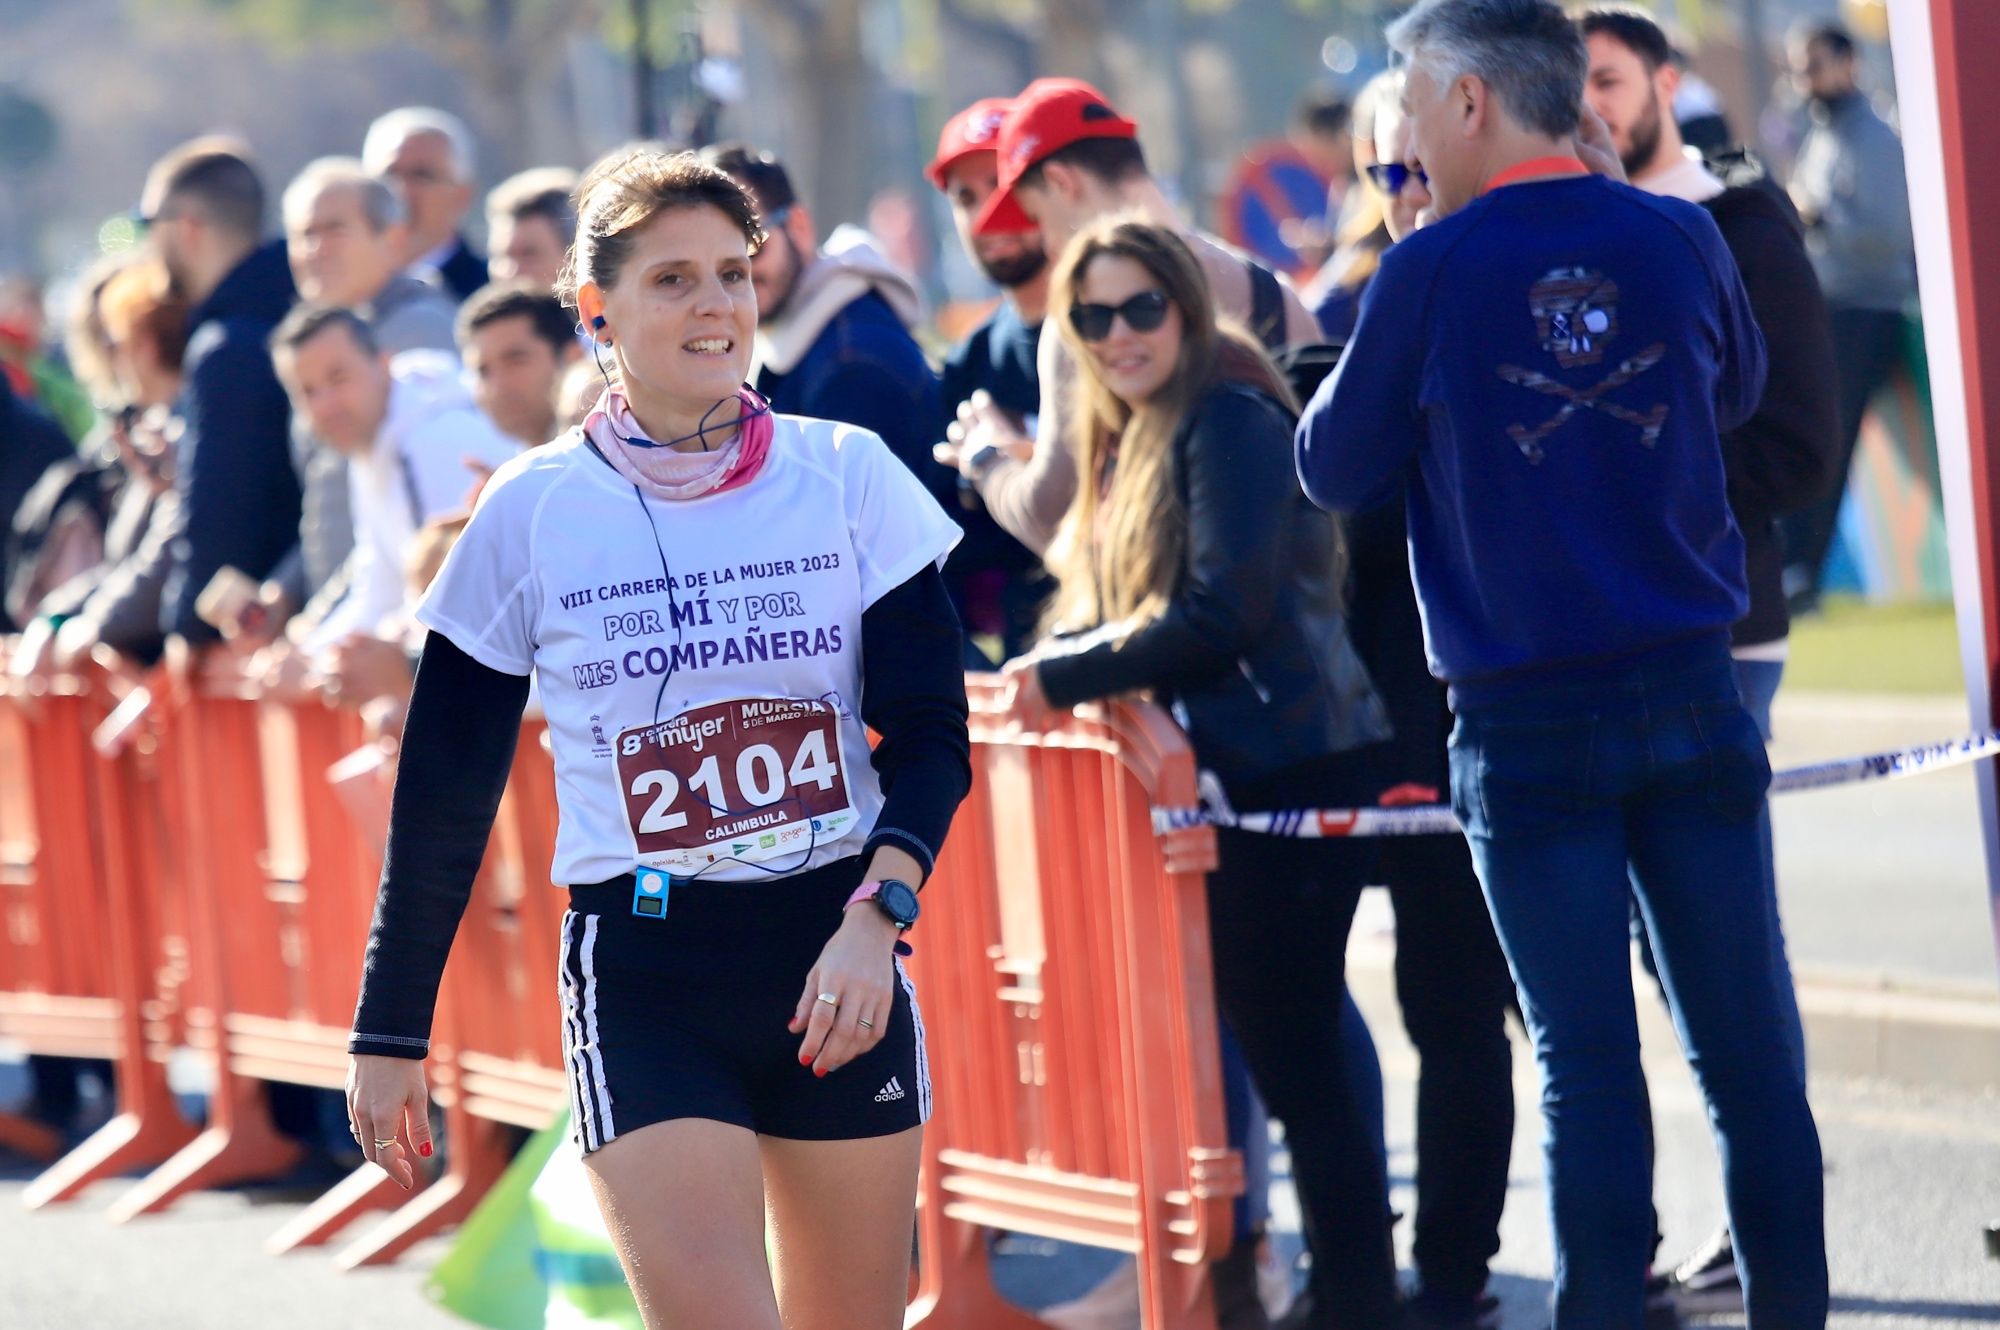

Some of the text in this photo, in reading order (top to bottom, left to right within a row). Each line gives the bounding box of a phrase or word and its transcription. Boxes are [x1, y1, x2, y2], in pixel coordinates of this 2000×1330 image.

[560, 553, 840, 611] VIII CARRERA DE LA MUJER 2023
[604, 589, 805, 641] POR MÍ Y POR
[573, 625, 842, 690] MIS COMPAÑERAS
[659, 715, 725, 753] mujer
[742, 720, 750, 729] 5
[751, 718, 764, 727] DE
[766, 711, 801, 724] MARZO
[631, 729, 838, 834] 2104
[705, 810, 788, 841] CALIMBULA
[874, 1089, 905, 1103] adidas
